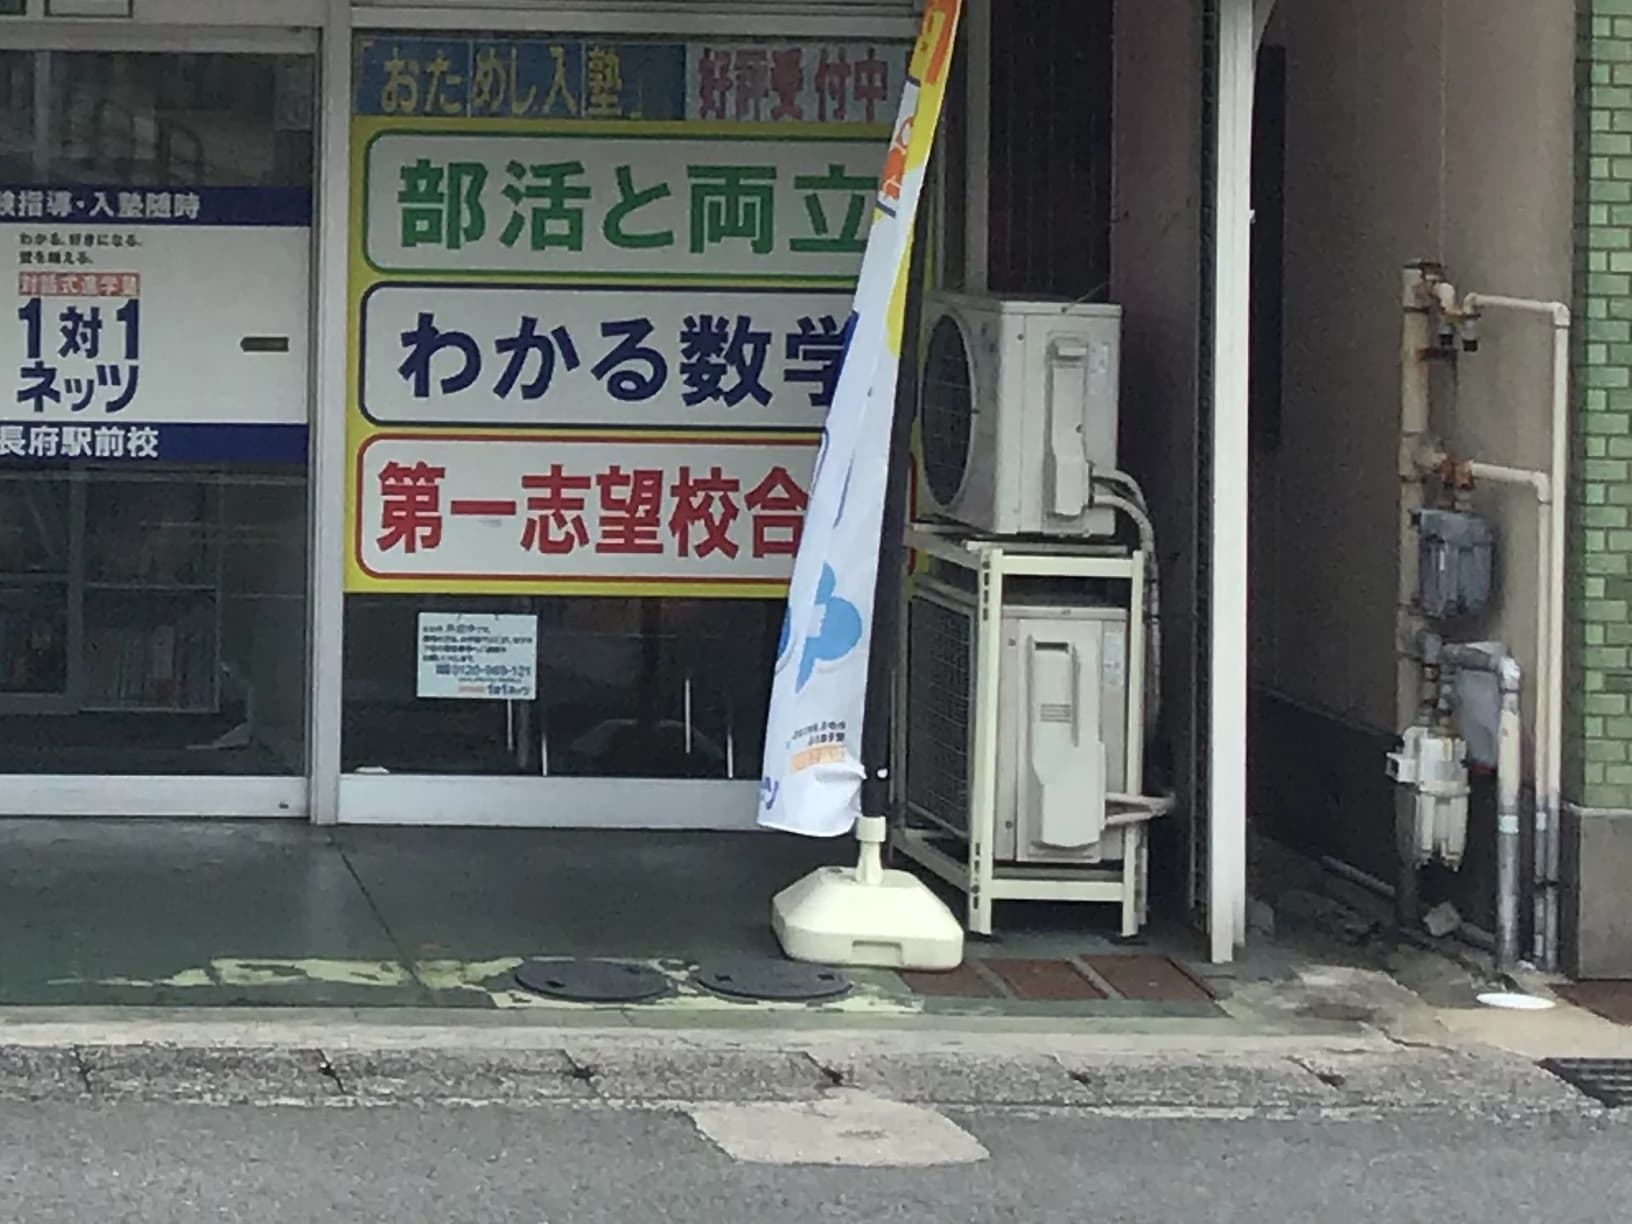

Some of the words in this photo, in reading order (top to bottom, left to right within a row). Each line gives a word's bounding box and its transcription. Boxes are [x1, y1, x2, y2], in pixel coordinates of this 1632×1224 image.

[396, 158, 880, 255] 部活と両立
[17, 297, 140, 360] 1対1
[16, 360, 141, 413] ネッツ
